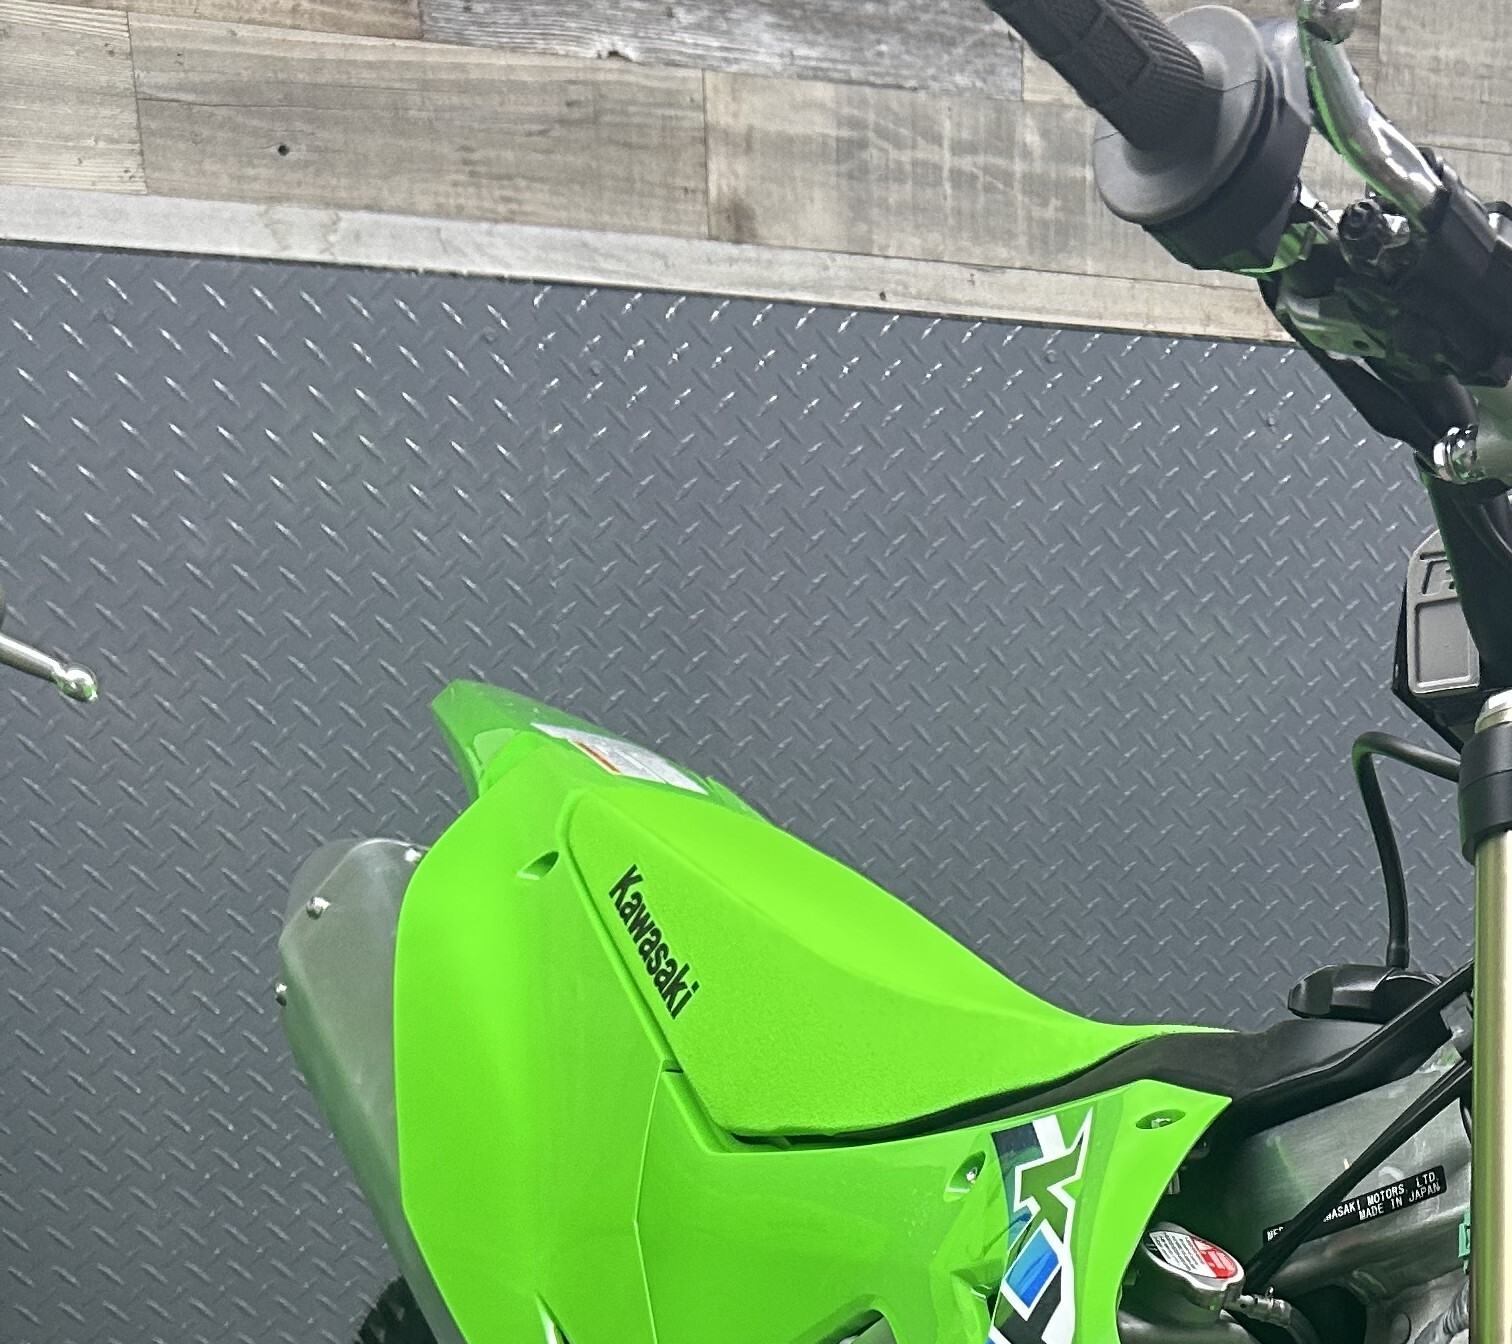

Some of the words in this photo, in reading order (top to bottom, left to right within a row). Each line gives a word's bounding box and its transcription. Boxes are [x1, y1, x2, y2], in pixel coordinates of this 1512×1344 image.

[608, 864, 700, 1020] Kawasaki
[1359, 1202, 1385, 1221] MADE
[1391, 1197, 1403, 1210] IN
[1409, 1182, 1441, 1202] JAPAN
